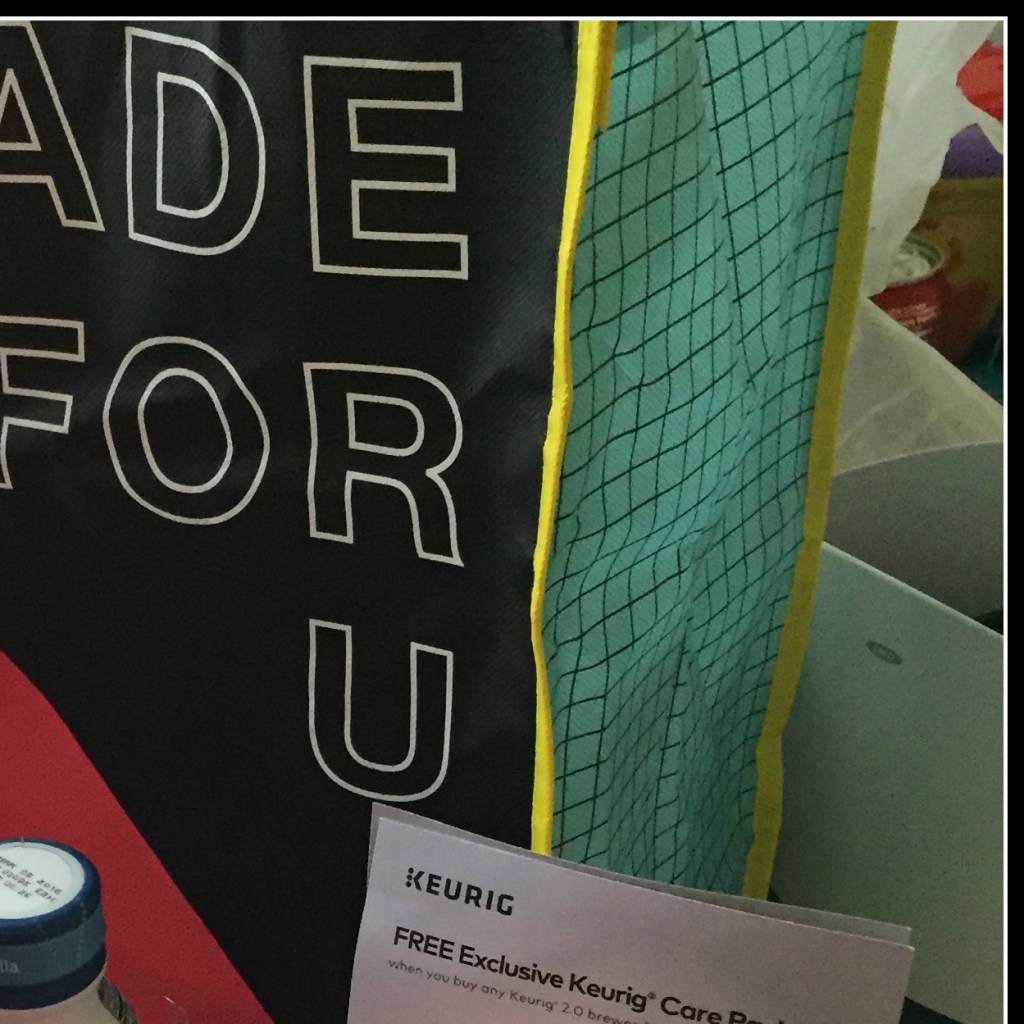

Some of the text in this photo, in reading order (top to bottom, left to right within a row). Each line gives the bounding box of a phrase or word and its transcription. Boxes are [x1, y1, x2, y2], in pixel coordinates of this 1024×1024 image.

[308, 618, 454, 803] U
[405, 866, 515, 916] KEURIG
[388, 959, 423, 976] when
[425, 969, 450, 984] you
[453, 975, 478, 993] buy
[480, 983, 506, 1000] any
[561, 1002, 584, 1017] 2.0
[393, 925, 453, 961] FREE
[459, 944, 564, 990] Exclusive
